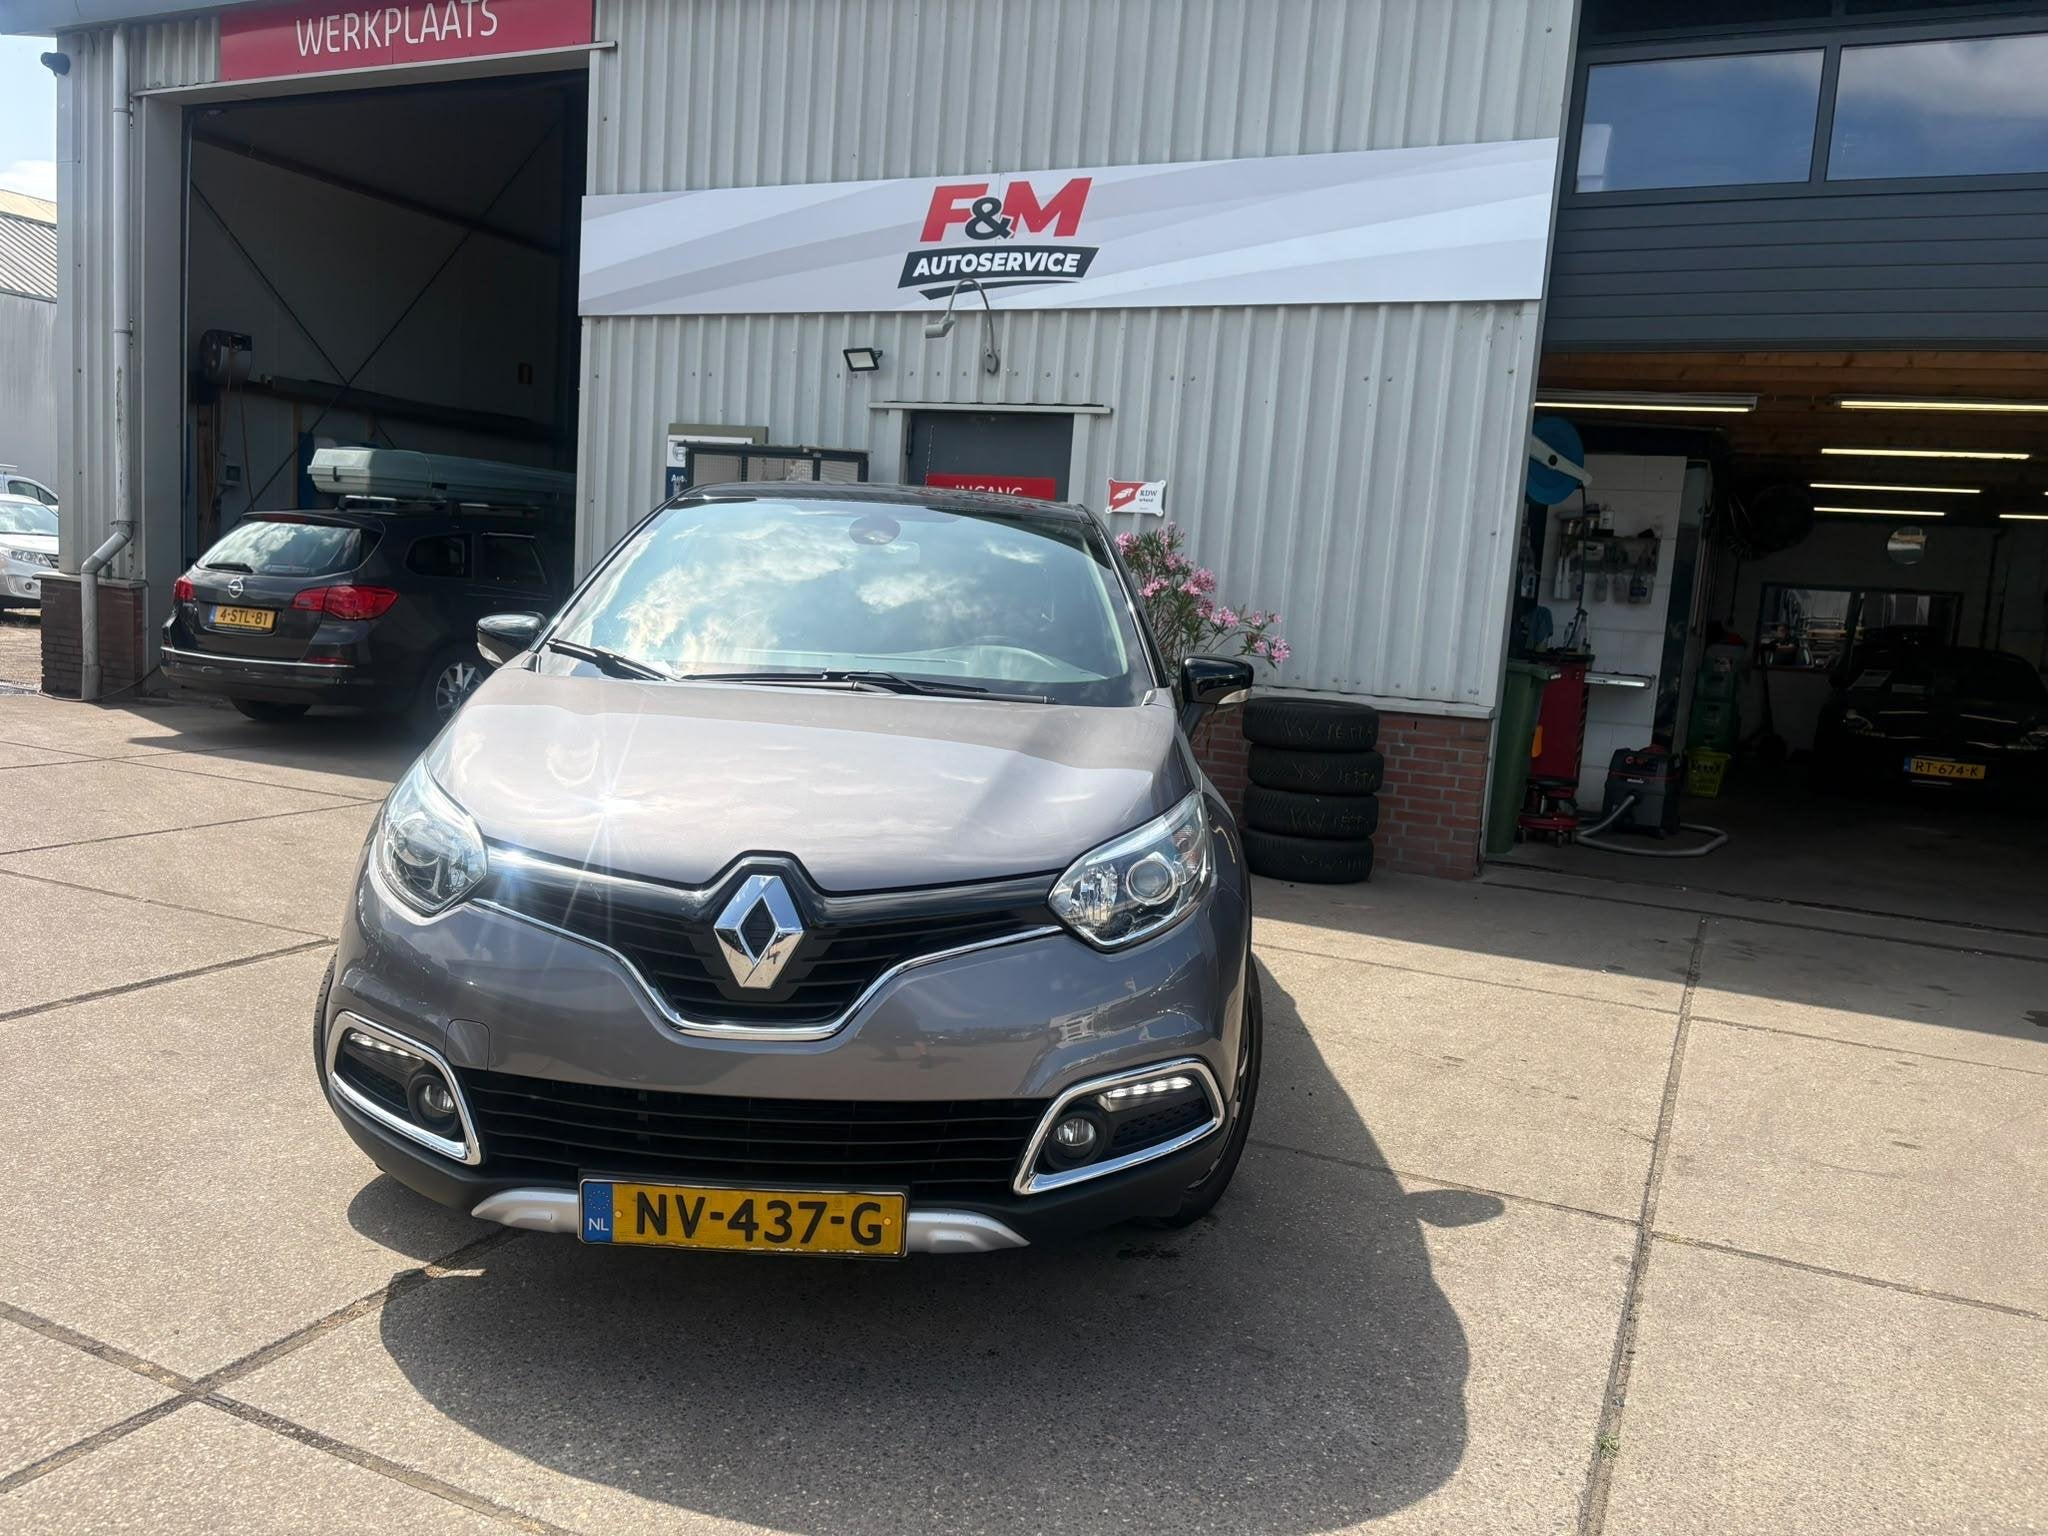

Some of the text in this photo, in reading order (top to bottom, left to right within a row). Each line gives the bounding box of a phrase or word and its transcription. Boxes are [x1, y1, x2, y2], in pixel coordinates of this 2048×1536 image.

[295, 0, 499, 57] WERKPLAATS
[919, 176, 1093, 242] F&M
[912, 251, 1082, 277] AUTOSERVICE
[219, 607, 269, 625] 4-STL-81
[1914, 759, 1979, 777] RT-674-K
[588, 1190, 884, 1247] NL NV-437-G
